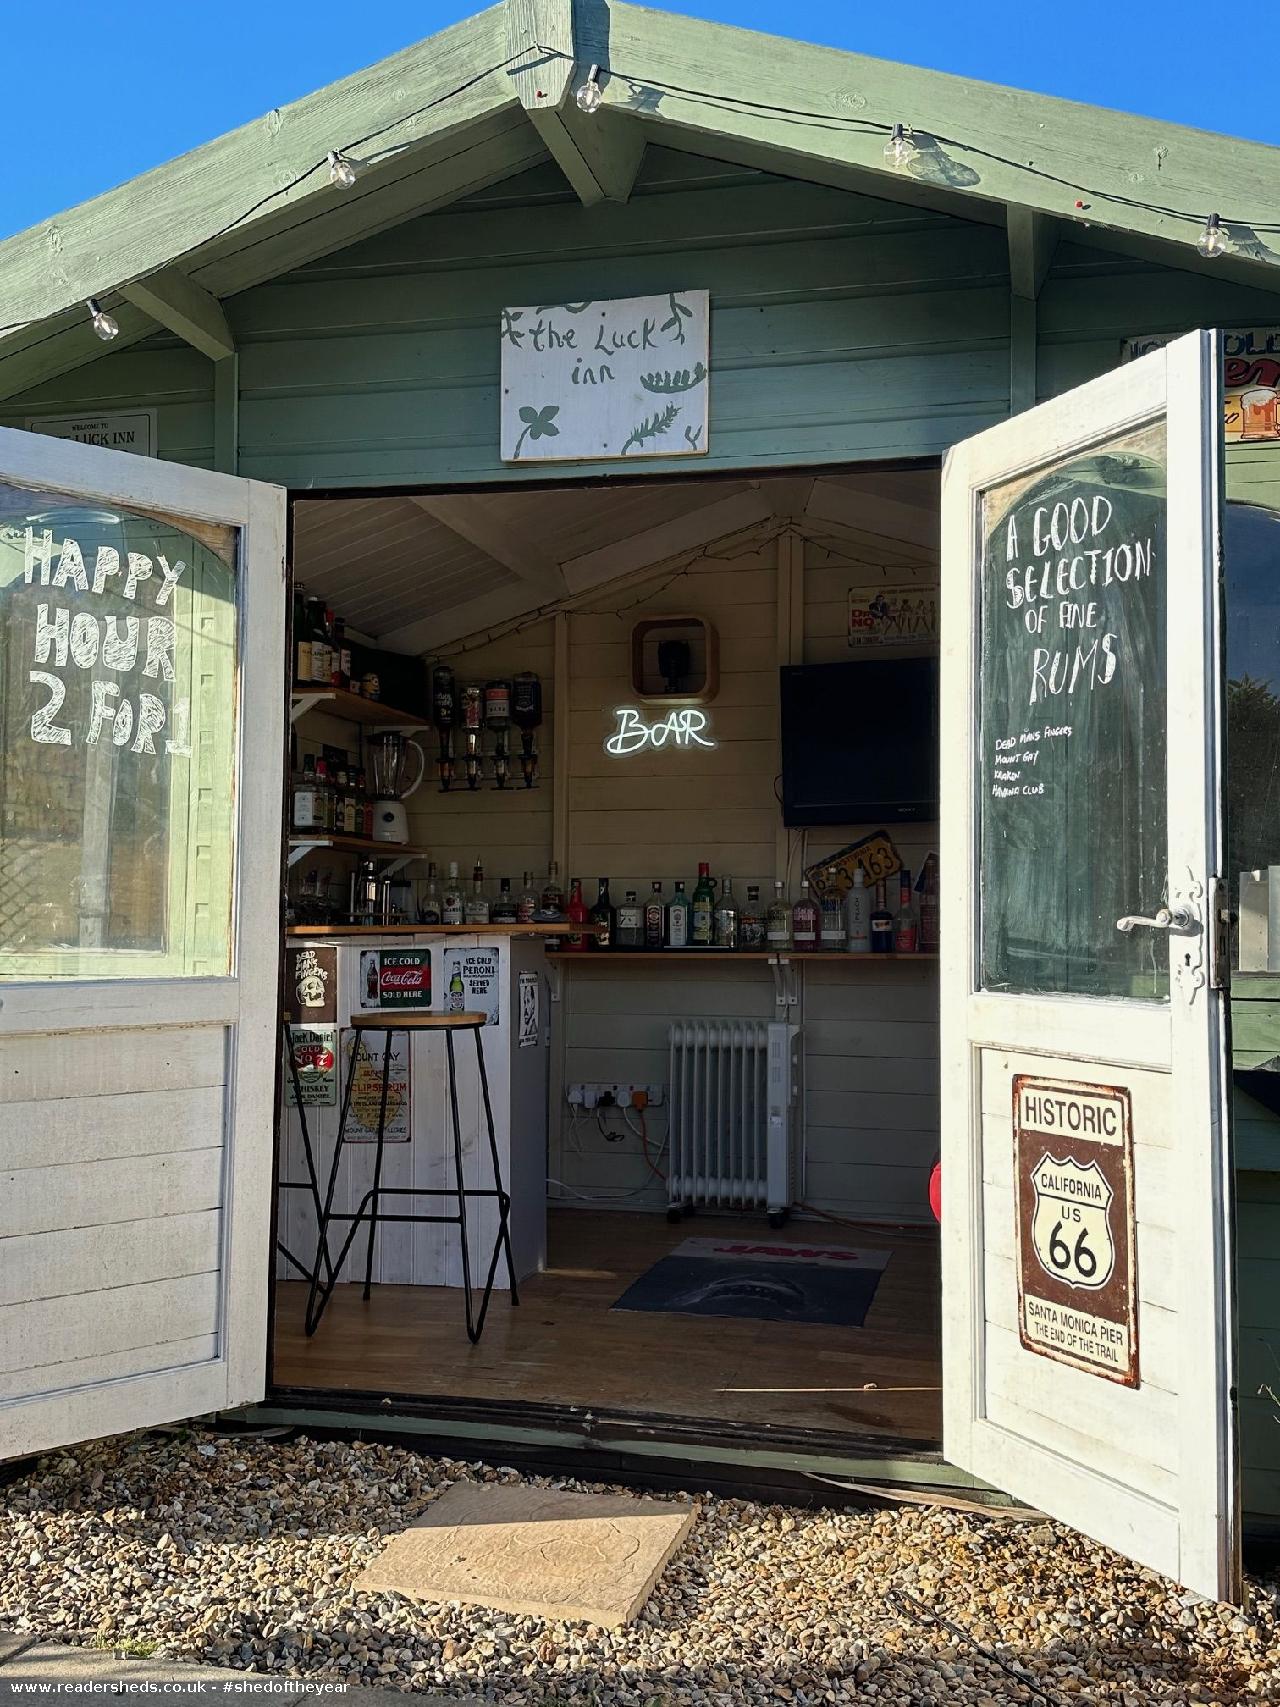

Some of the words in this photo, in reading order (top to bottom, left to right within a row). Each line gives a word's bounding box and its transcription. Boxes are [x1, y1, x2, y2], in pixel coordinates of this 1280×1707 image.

[529, 319, 578, 352] the
[594, 318, 659, 355] Luck
[571, 357, 615, 385] inn
[113, 431, 135, 443] INN
[1006, 515, 1019, 562] A
[1033, 495, 1112, 556] GOOD
[25, 526, 187, 606] HAPPY
[1006, 538, 1151, 609] SELECTION
[1025, 605, 1048, 633] OF
[34, 603, 177, 682] HOUR
[1029, 633, 1118, 705] RUMS
[30, 670, 72, 746] 2
[86, 681, 166, 755] FOR
[995, 736, 1017, 751] DEAD
[994, 753, 1021, 765] MOUNT
[1022, 749, 1040, 766] GAY
[994, 769, 1021, 781] KRAKEN
[1022, 782, 1045, 795] CLUB
[295, 950, 316, 963] DEAD
[384, 957, 397, 966] ICE
[400, 956, 420, 965] COLD
[465, 957, 476, 965] ICE
[477, 957, 492, 965] COLD
[295, 967, 329, 981] FINGERS
[463, 965, 495, 975] PERONI
[382, 991, 402, 999] SOLD
[471, 987, 488, 995] HERE
[316, 1053, 329, 1066] 7
[354, 1053, 379, 1062] OUNT
[1025, 1096, 1117, 1137] HISTORIC
[1041, 1173, 1102, 1200] CALIFORNIA
[1062, 1205, 1081, 1223] US
[1049, 1220, 1097, 1278] 66
[1028, 1301, 1058, 1323] SANTA
[1060, 1312, 1098, 1338] MONICA
[1100, 1325, 1124, 1346] PIER
[1034, 1321, 1049, 1339] THE
[1050, 1327, 1066, 1346] END
[1067, 1333, 1078, 1348] OF
[1079, 1338, 1095, 1354] THE
[1095, 1342, 1119, 1364] TRAIL
